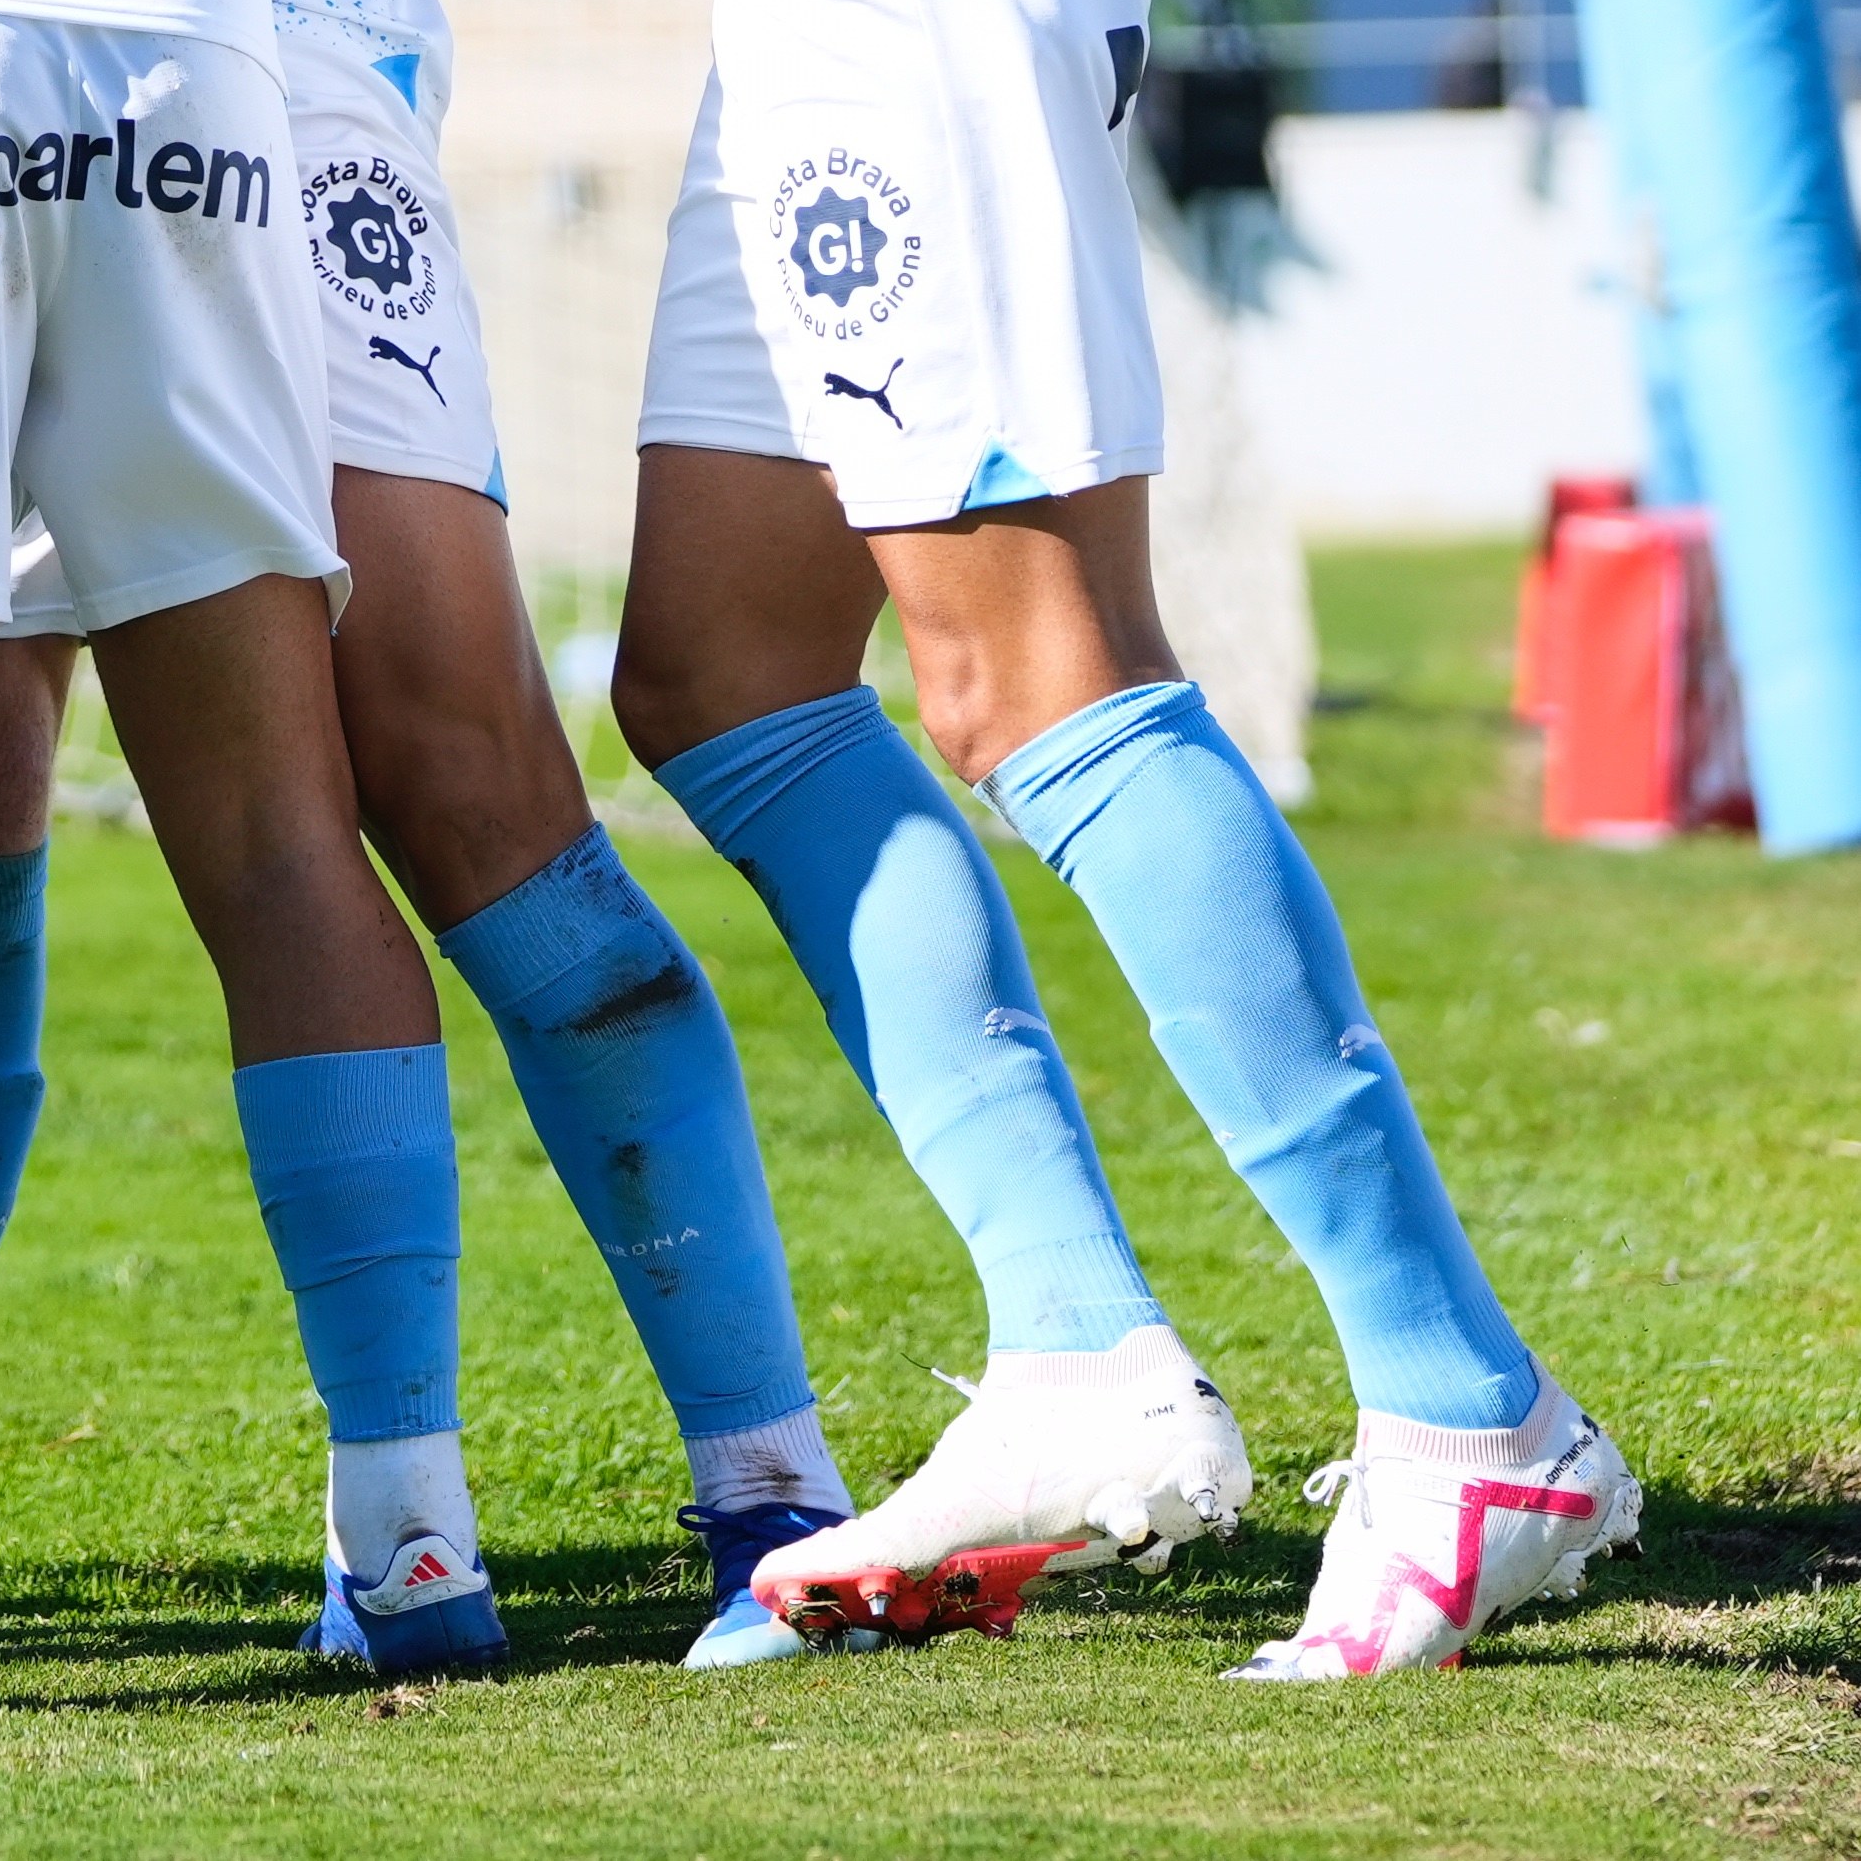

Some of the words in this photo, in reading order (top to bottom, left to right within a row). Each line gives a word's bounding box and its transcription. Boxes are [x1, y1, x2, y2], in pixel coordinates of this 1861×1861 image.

[368, 156, 428, 237] Brava
[769, 159, 817, 239] Costa
[827, 147, 911, 218] Brava
[383, 300, 409, 320] de
[409, 254, 437, 316] Girona
[835, 318, 864, 340] de
[869, 235, 921, 323] Girona
[1545, 1434, 1593, 1485] CONSTANTINO
